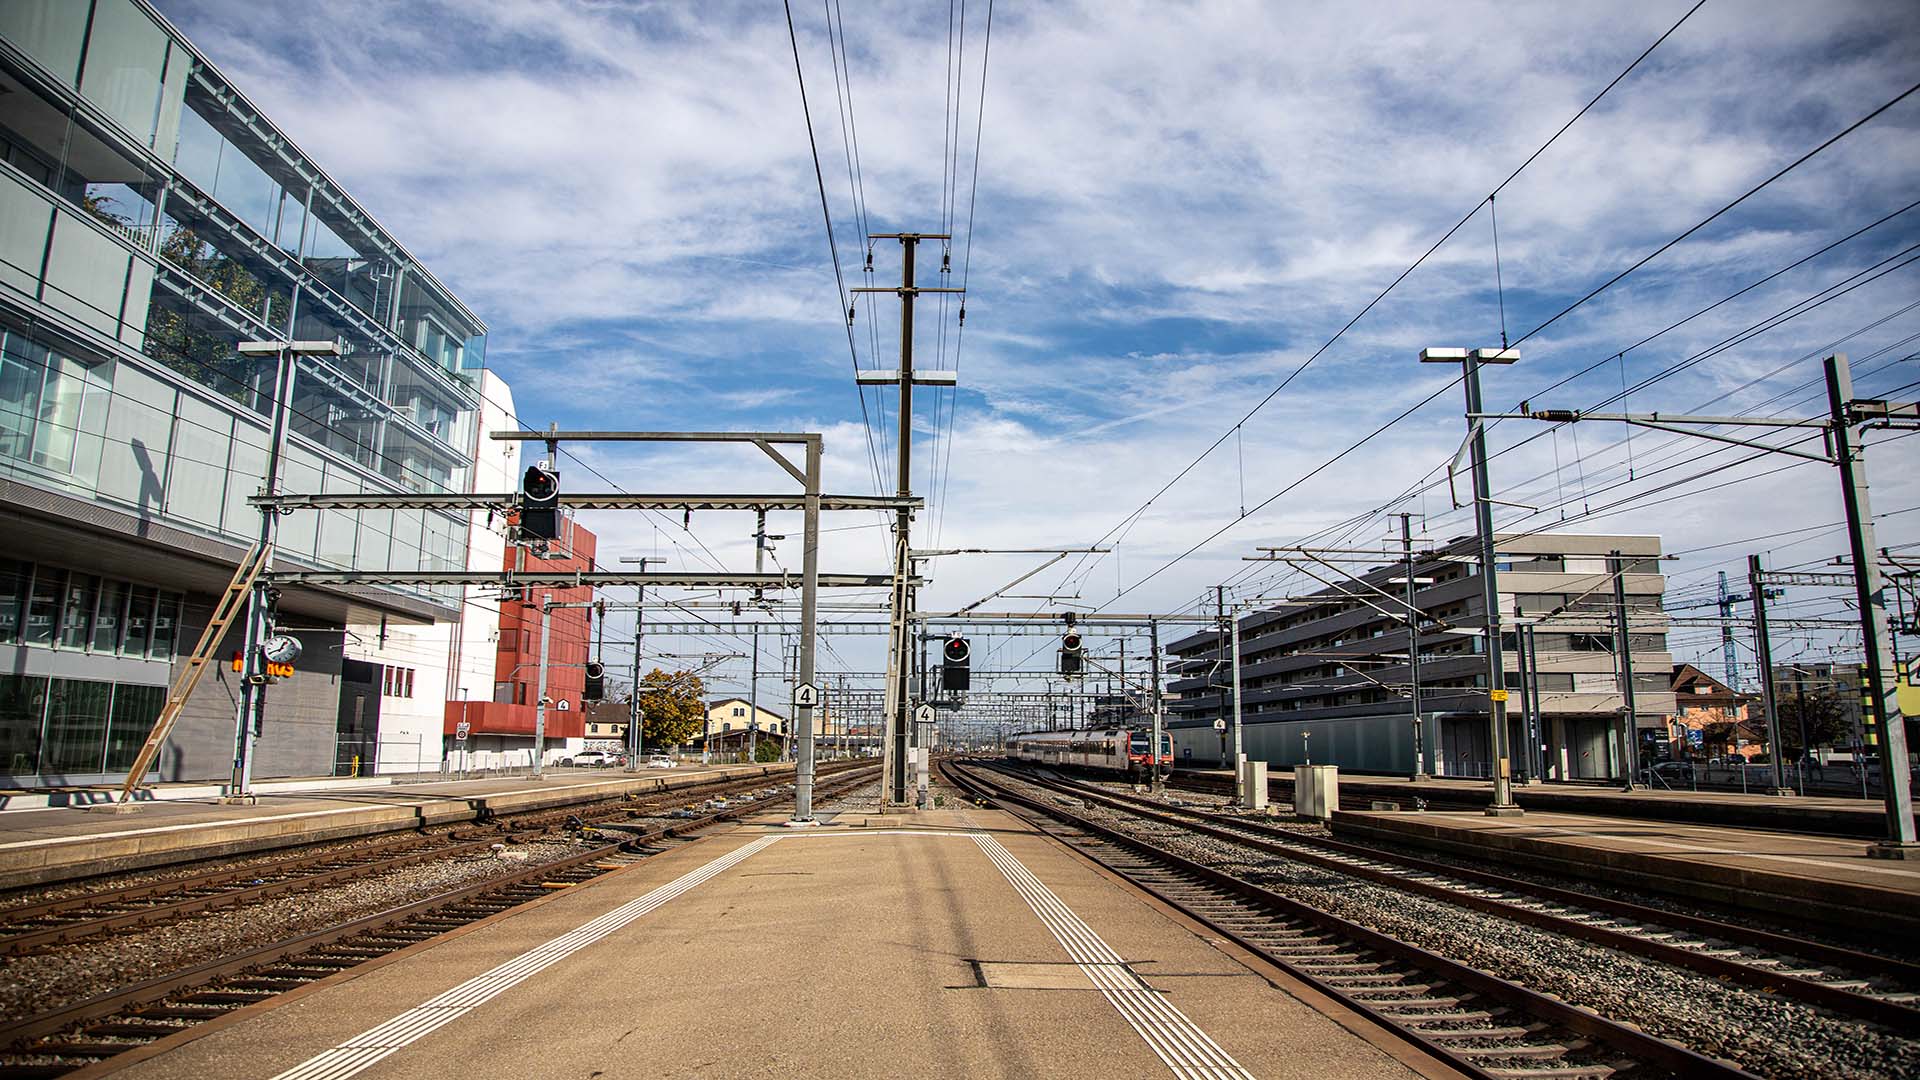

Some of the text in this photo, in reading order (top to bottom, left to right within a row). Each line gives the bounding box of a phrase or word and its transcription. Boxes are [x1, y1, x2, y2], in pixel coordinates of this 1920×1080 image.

[800, 689, 811, 703] 4
[560, 701, 566, 709] 4
[920, 707, 930, 720] 4
